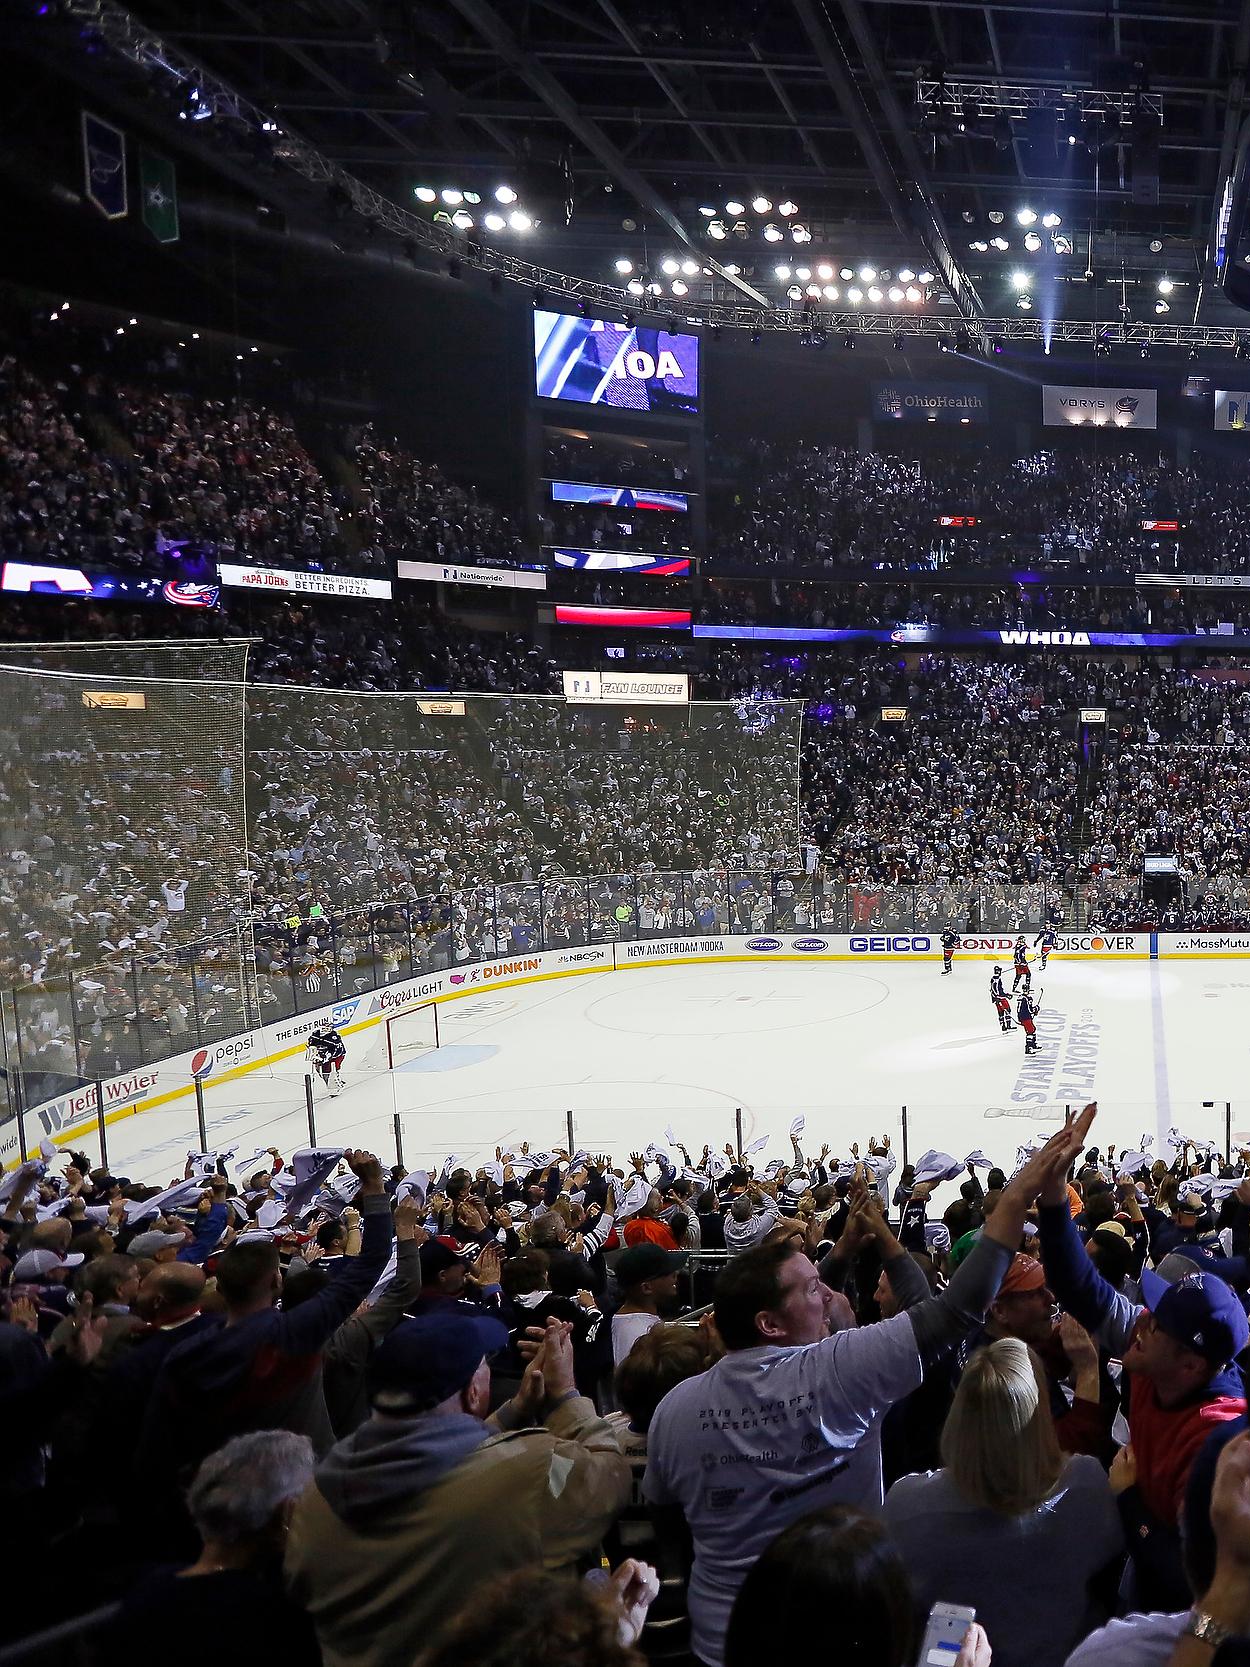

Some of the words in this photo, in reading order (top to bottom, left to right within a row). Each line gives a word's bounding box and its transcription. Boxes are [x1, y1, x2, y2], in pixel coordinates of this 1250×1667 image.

[904, 395, 983, 409] OhioHealth
[1059, 398, 1105, 409] VORYS
[241, 574, 262, 585] PAPA
[294, 573, 322, 582] BETTER
[460, 571, 503, 582] Nationwide
[1192, 577, 1242, 586] LET'S
[295, 581, 335, 593] BETTER
[338, 585, 370, 596] PIZZA.
[999, 630, 1091, 646] WHOA
[602, 683, 628, 694] FAN
[631, 684, 683, 695] LOUNGE
[627, 945, 646, 957] NEW
[647, 943, 699, 956] AMSTERDAM
[700, 941, 724, 953] VODKA
[748, 941, 779, 950] cars.com
[794, 940, 825, 950] cars.com
[850, 937, 931, 952] GEICO
[1056, 936, 1135, 951] DISCOVER
[568, 951, 604, 963] NBCSN
[483, 958, 542, 978] DUNKIN'
[379, 989, 413, 1010] Coors
[413, 980, 443, 998] LIGHT
[332, 1004, 355, 1024] SAP
[275, 1030, 292, 1042] THE
[292, 1024, 313, 1040] BEST
[313, 1016, 330, 1030] RUN
[215, 1035, 255, 1063] pepsi
[1056, 1023, 1101, 1100] PLAYOFFS
[68, 1086, 98, 1118] Jeff
[106, 1071, 160, 1101] Wyler
[740, 1391, 816, 1417] PLAYOFFS
[702, 1413, 788, 1431] PRESENTED
[795, 1404, 814, 1418] BY
